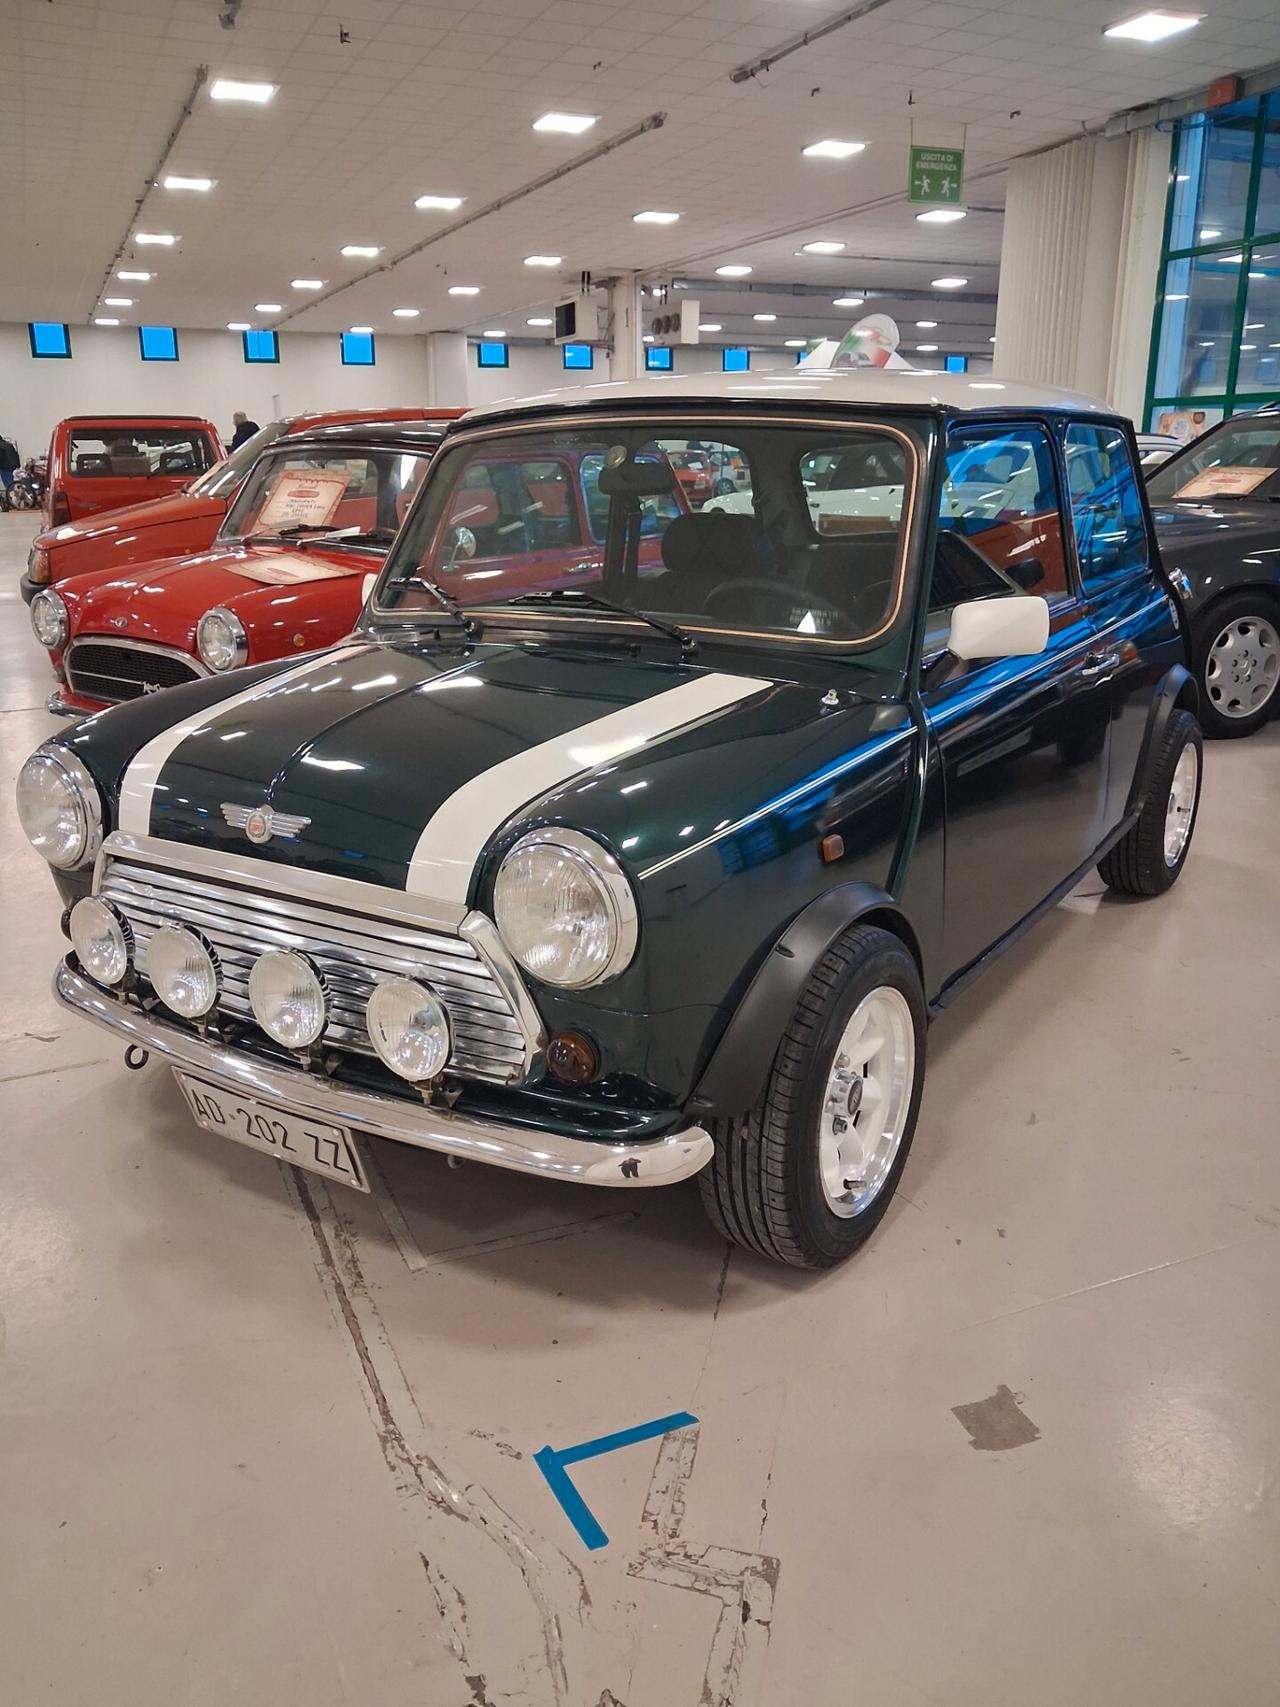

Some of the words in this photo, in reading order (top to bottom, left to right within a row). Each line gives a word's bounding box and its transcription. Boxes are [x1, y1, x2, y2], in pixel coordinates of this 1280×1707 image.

[920, 153, 945, 161] USCITA
[946, 154, 954, 162] DI
[915, 161, 957, 171] EMERGENZA
[236, 1108, 297, 1152] 202
[304, 1132, 349, 1173] ZZ
